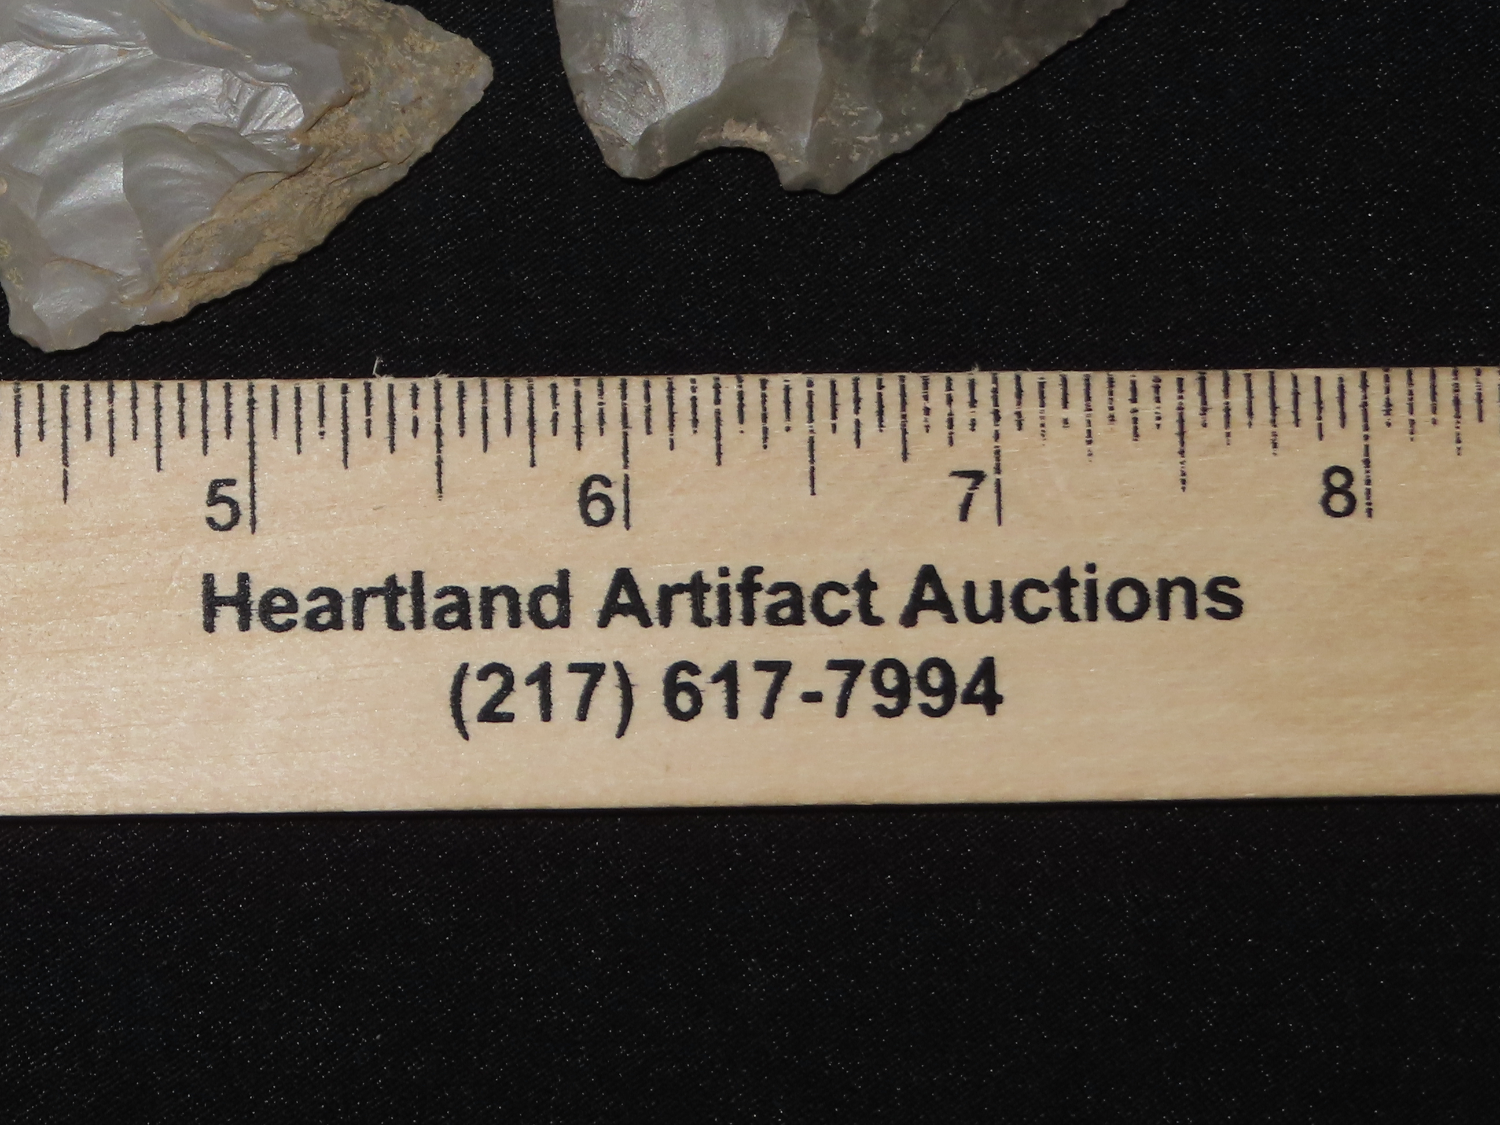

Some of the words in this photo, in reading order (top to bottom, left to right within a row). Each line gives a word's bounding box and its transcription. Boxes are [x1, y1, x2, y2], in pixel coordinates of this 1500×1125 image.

[206, 479, 242, 531] 5
[578, 474, 616, 527] 6
[949, 470, 987, 522] 7
[1319, 465, 1357, 518] 8
[202, 569, 573, 633] Heartland
[597, 566, 885, 628] Artifact
[899, 563, 1244, 628] Auctions
[450, 661, 635, 741] (217)
[663, 657, 1004, 722] 617-7994
